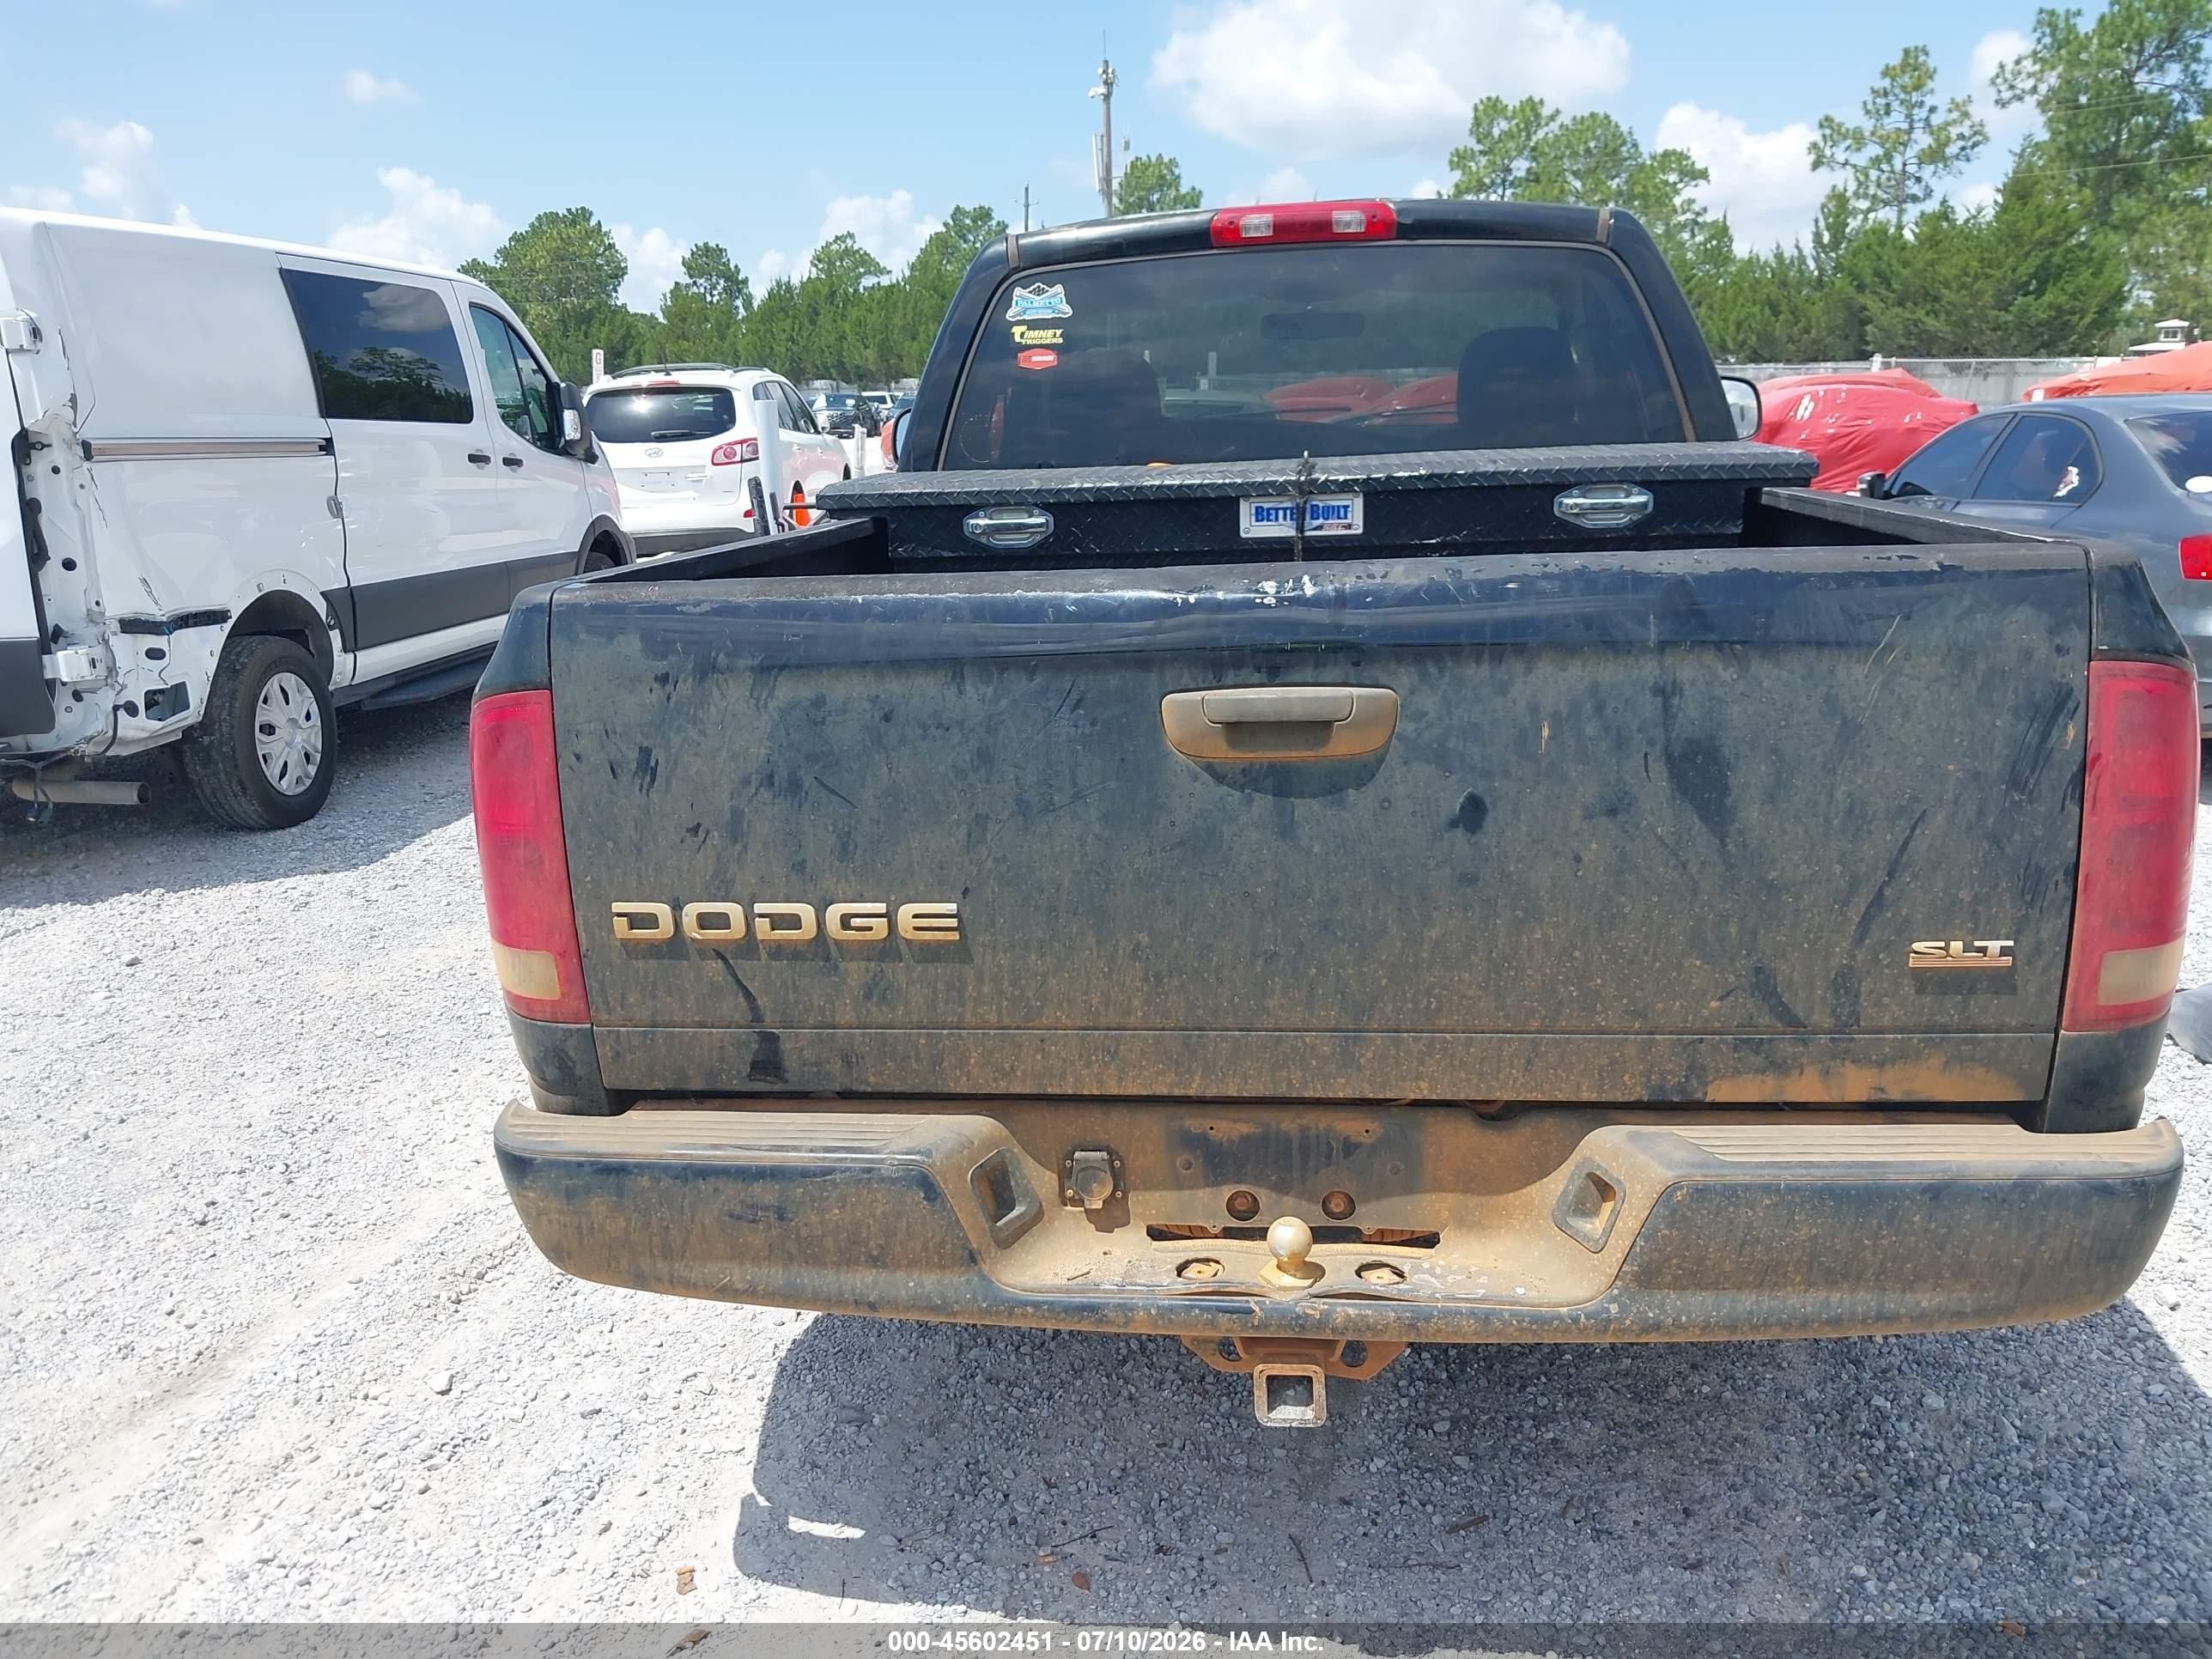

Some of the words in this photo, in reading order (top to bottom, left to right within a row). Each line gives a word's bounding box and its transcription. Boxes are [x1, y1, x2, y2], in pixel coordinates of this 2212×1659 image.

[1012, 325, 1064, 343] TIMNEY
[1255, 506, 1298, 522] BETTE
[611, 902, 960, 940] DODGE
[1910, 940, 2014, 959] SLT
